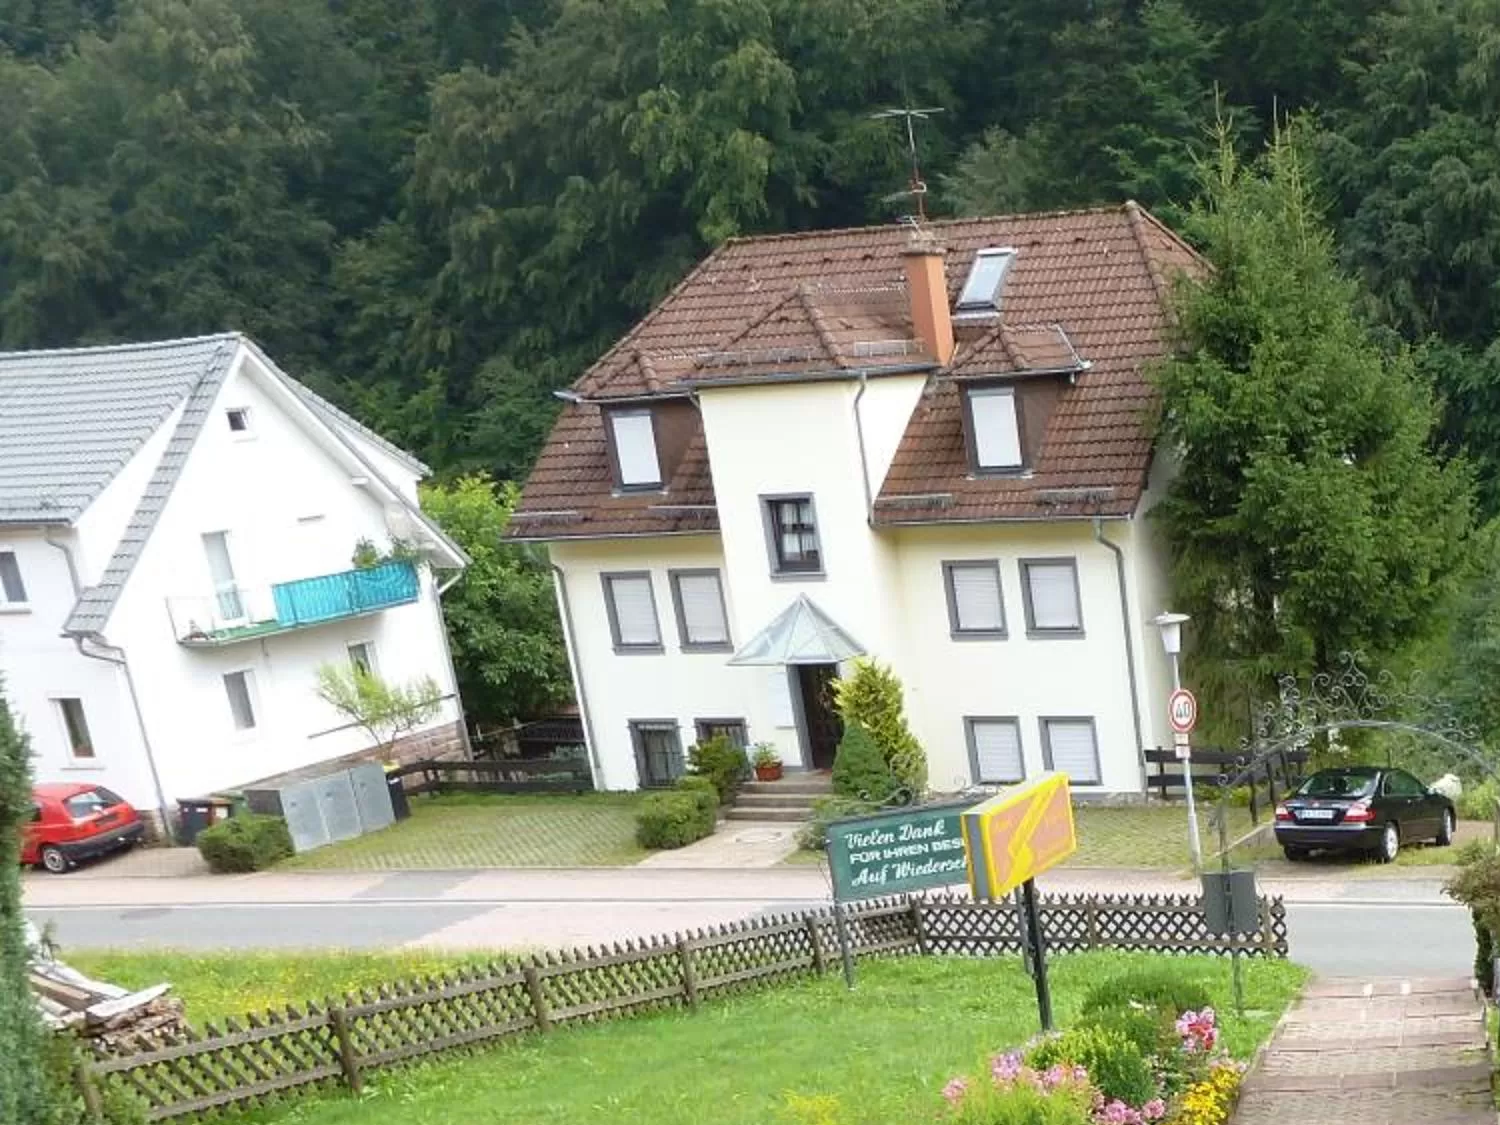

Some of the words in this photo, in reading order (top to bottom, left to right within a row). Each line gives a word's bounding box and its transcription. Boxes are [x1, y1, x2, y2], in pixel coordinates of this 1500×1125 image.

[1175, 701, 1190, 718] 40
[844, 829, 895, 849] Vielen
[898, 819, 945, 841] Dank
[883, 843, 929, 858] IHREN
[851, 864, 889, 886] Auf
